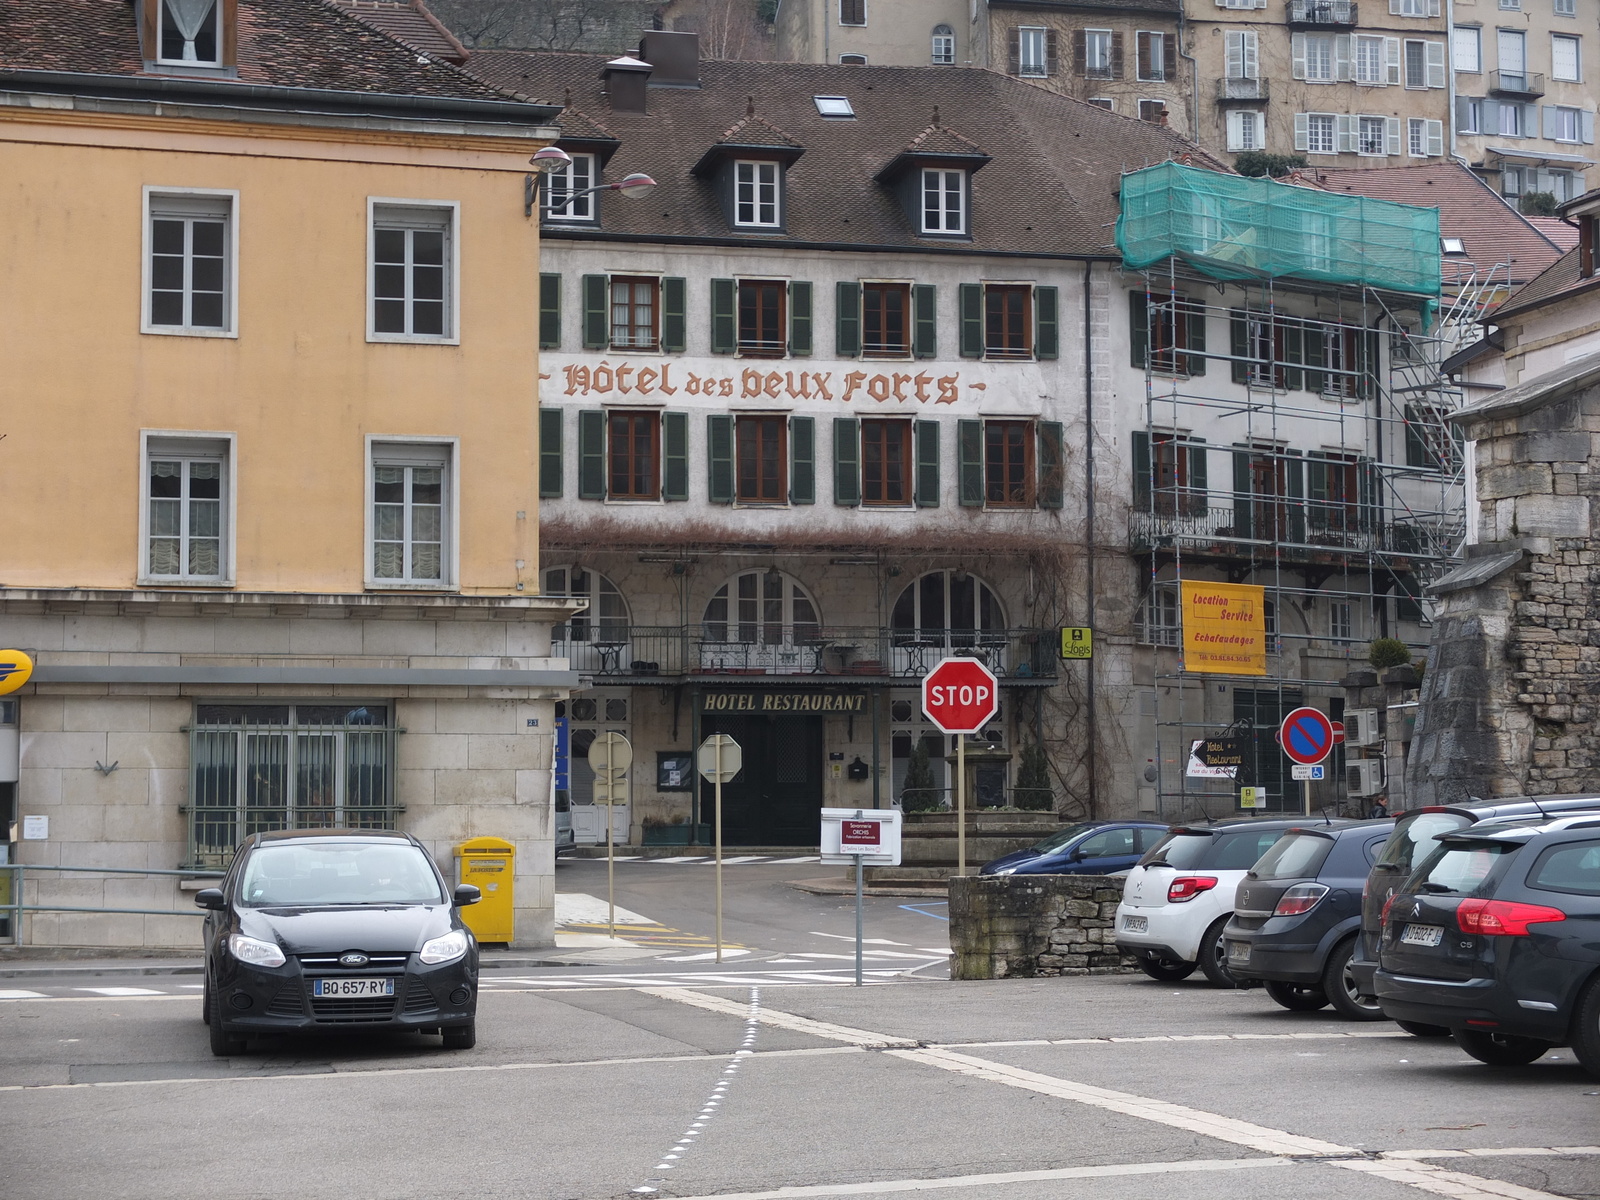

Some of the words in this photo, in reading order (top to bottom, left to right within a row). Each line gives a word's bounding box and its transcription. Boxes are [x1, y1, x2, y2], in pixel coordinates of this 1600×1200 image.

[562, 360, 678, 396] Hôtel
[684, 371, 734, 396] des
[841, 369, 960, 405] Forts
[1193, 593, 1229, 606] Location
[1220, 609, 1253, 622] Service
[1194, 632, 1255, 647] Echafaudages
[1064, 640, 1091, 657] Logis
[704, 693, 756, 710] HOTEL
[762, 694, 866, 711] RESTAURANT
[931, 685, 989, 706] STOP
[1460, 941, 1473, 949] C5
[345, 954, 362, 963] Ford
